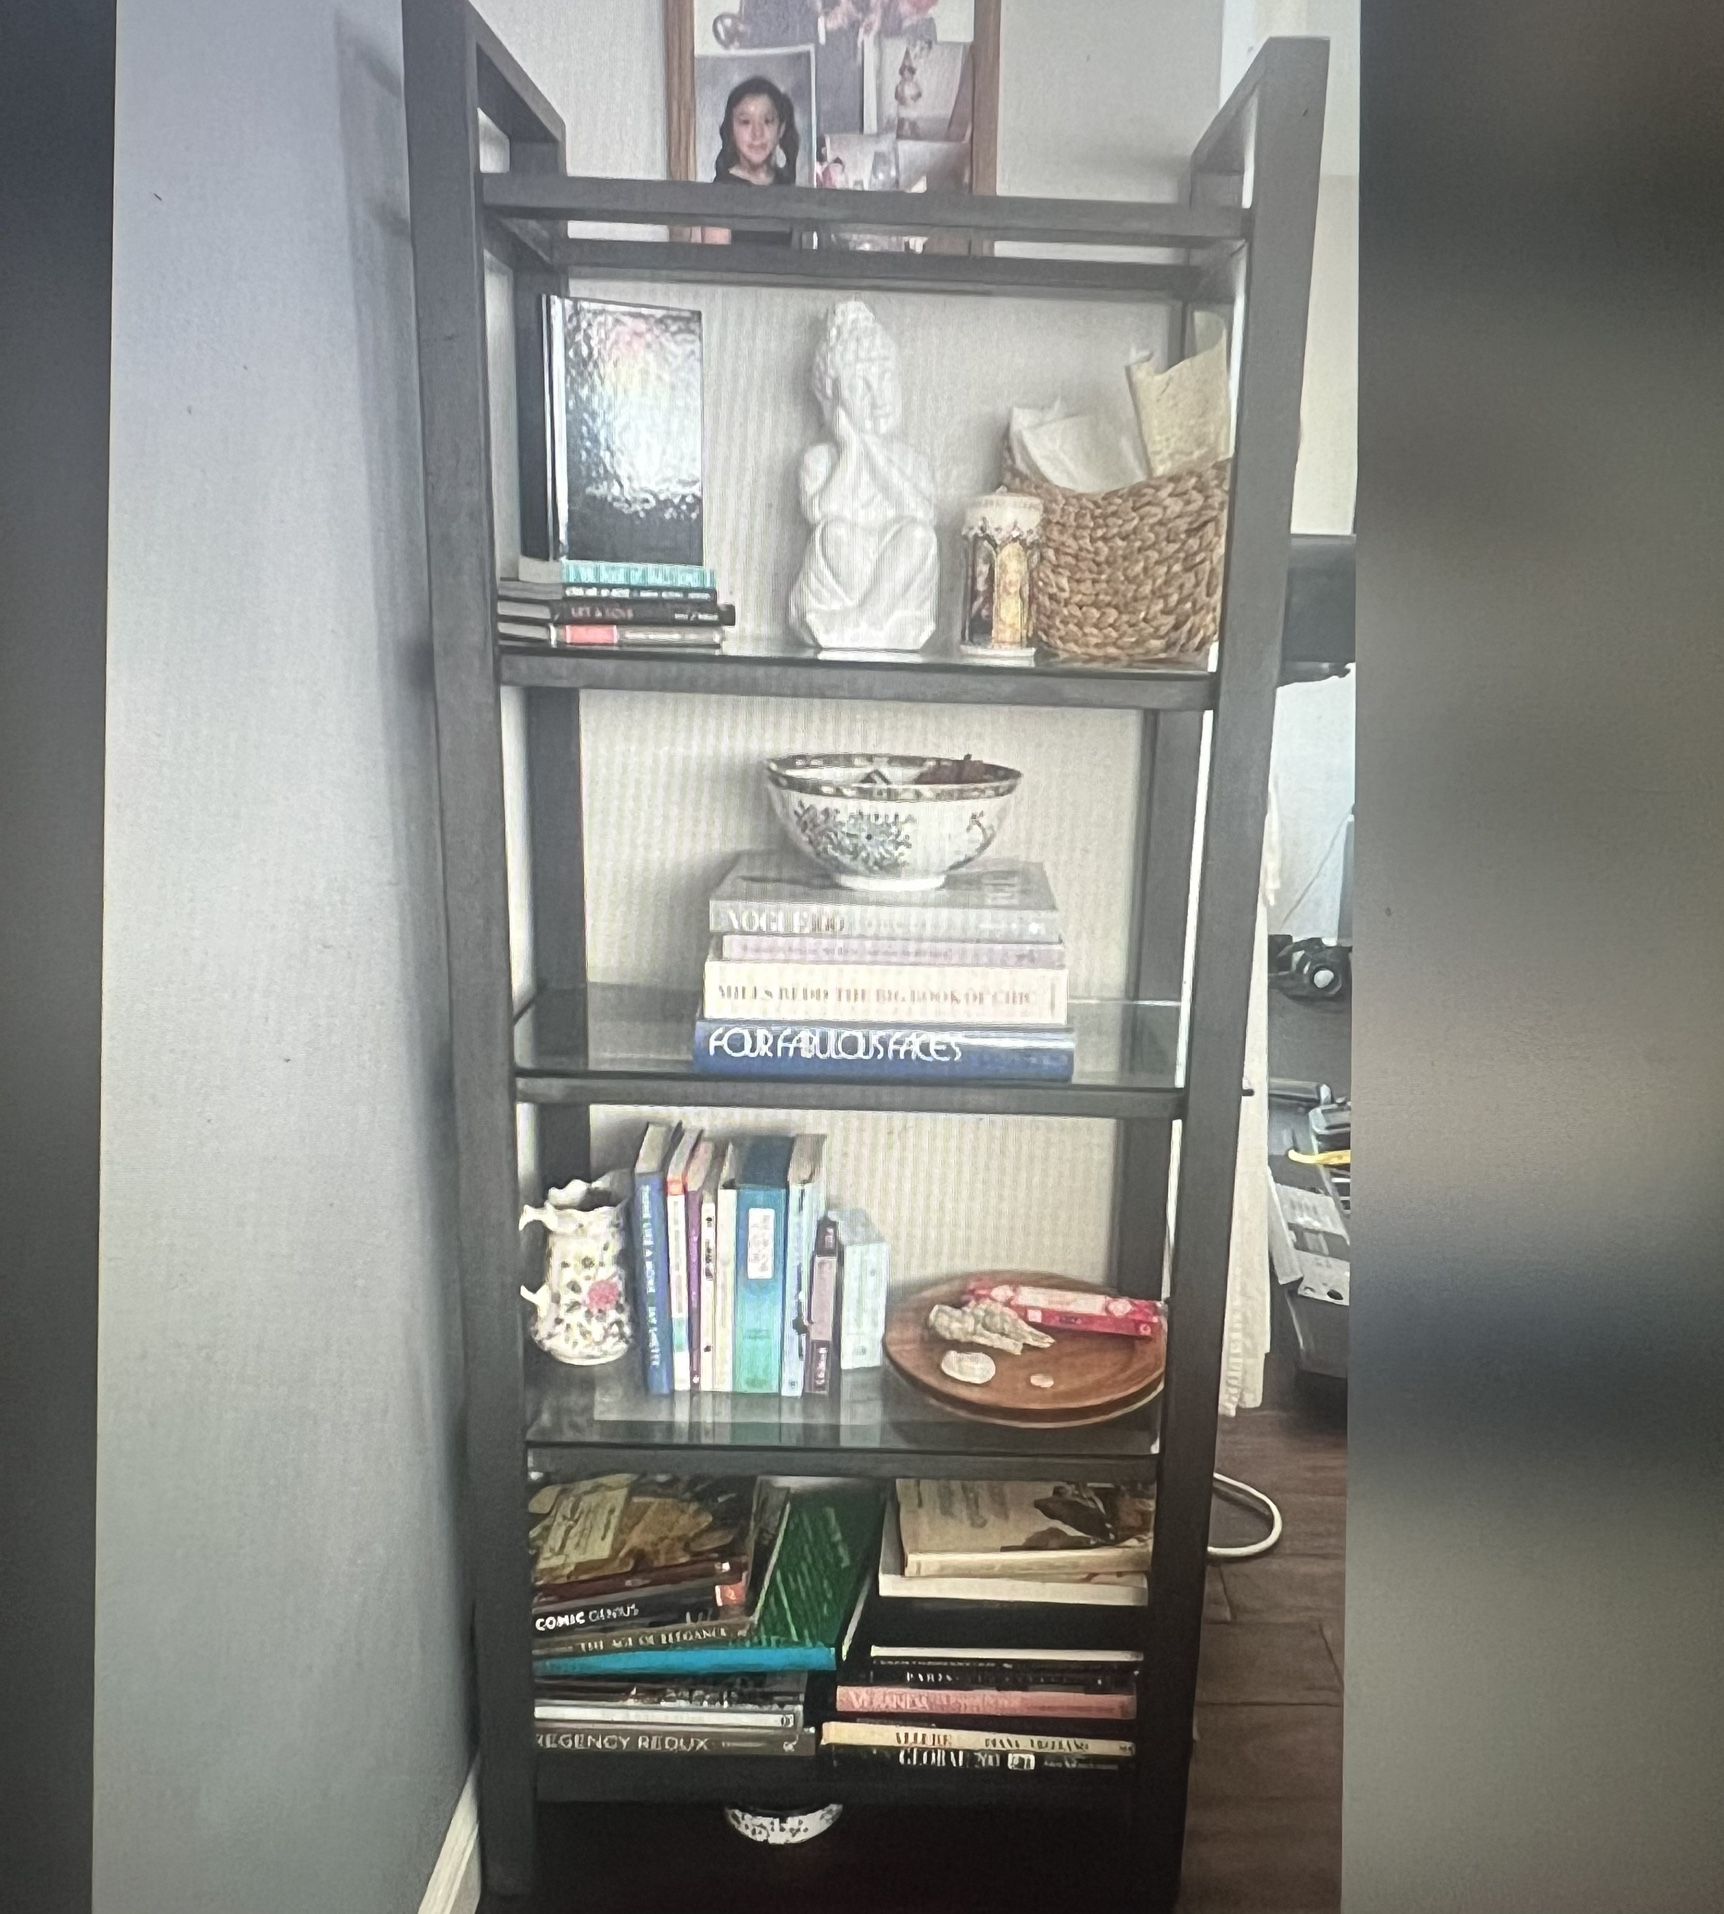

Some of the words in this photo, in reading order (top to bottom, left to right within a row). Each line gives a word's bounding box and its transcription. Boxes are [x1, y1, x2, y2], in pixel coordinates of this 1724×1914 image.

[708, 1027, 773, 1058] FOUR
[777, 1028, 884, 1060] FABULOUS
[888, 1029, 962, 1061] FACES
[535, 1611, 585, 1631] COMIC
[638, 1735, 710, 1751] REDUX
